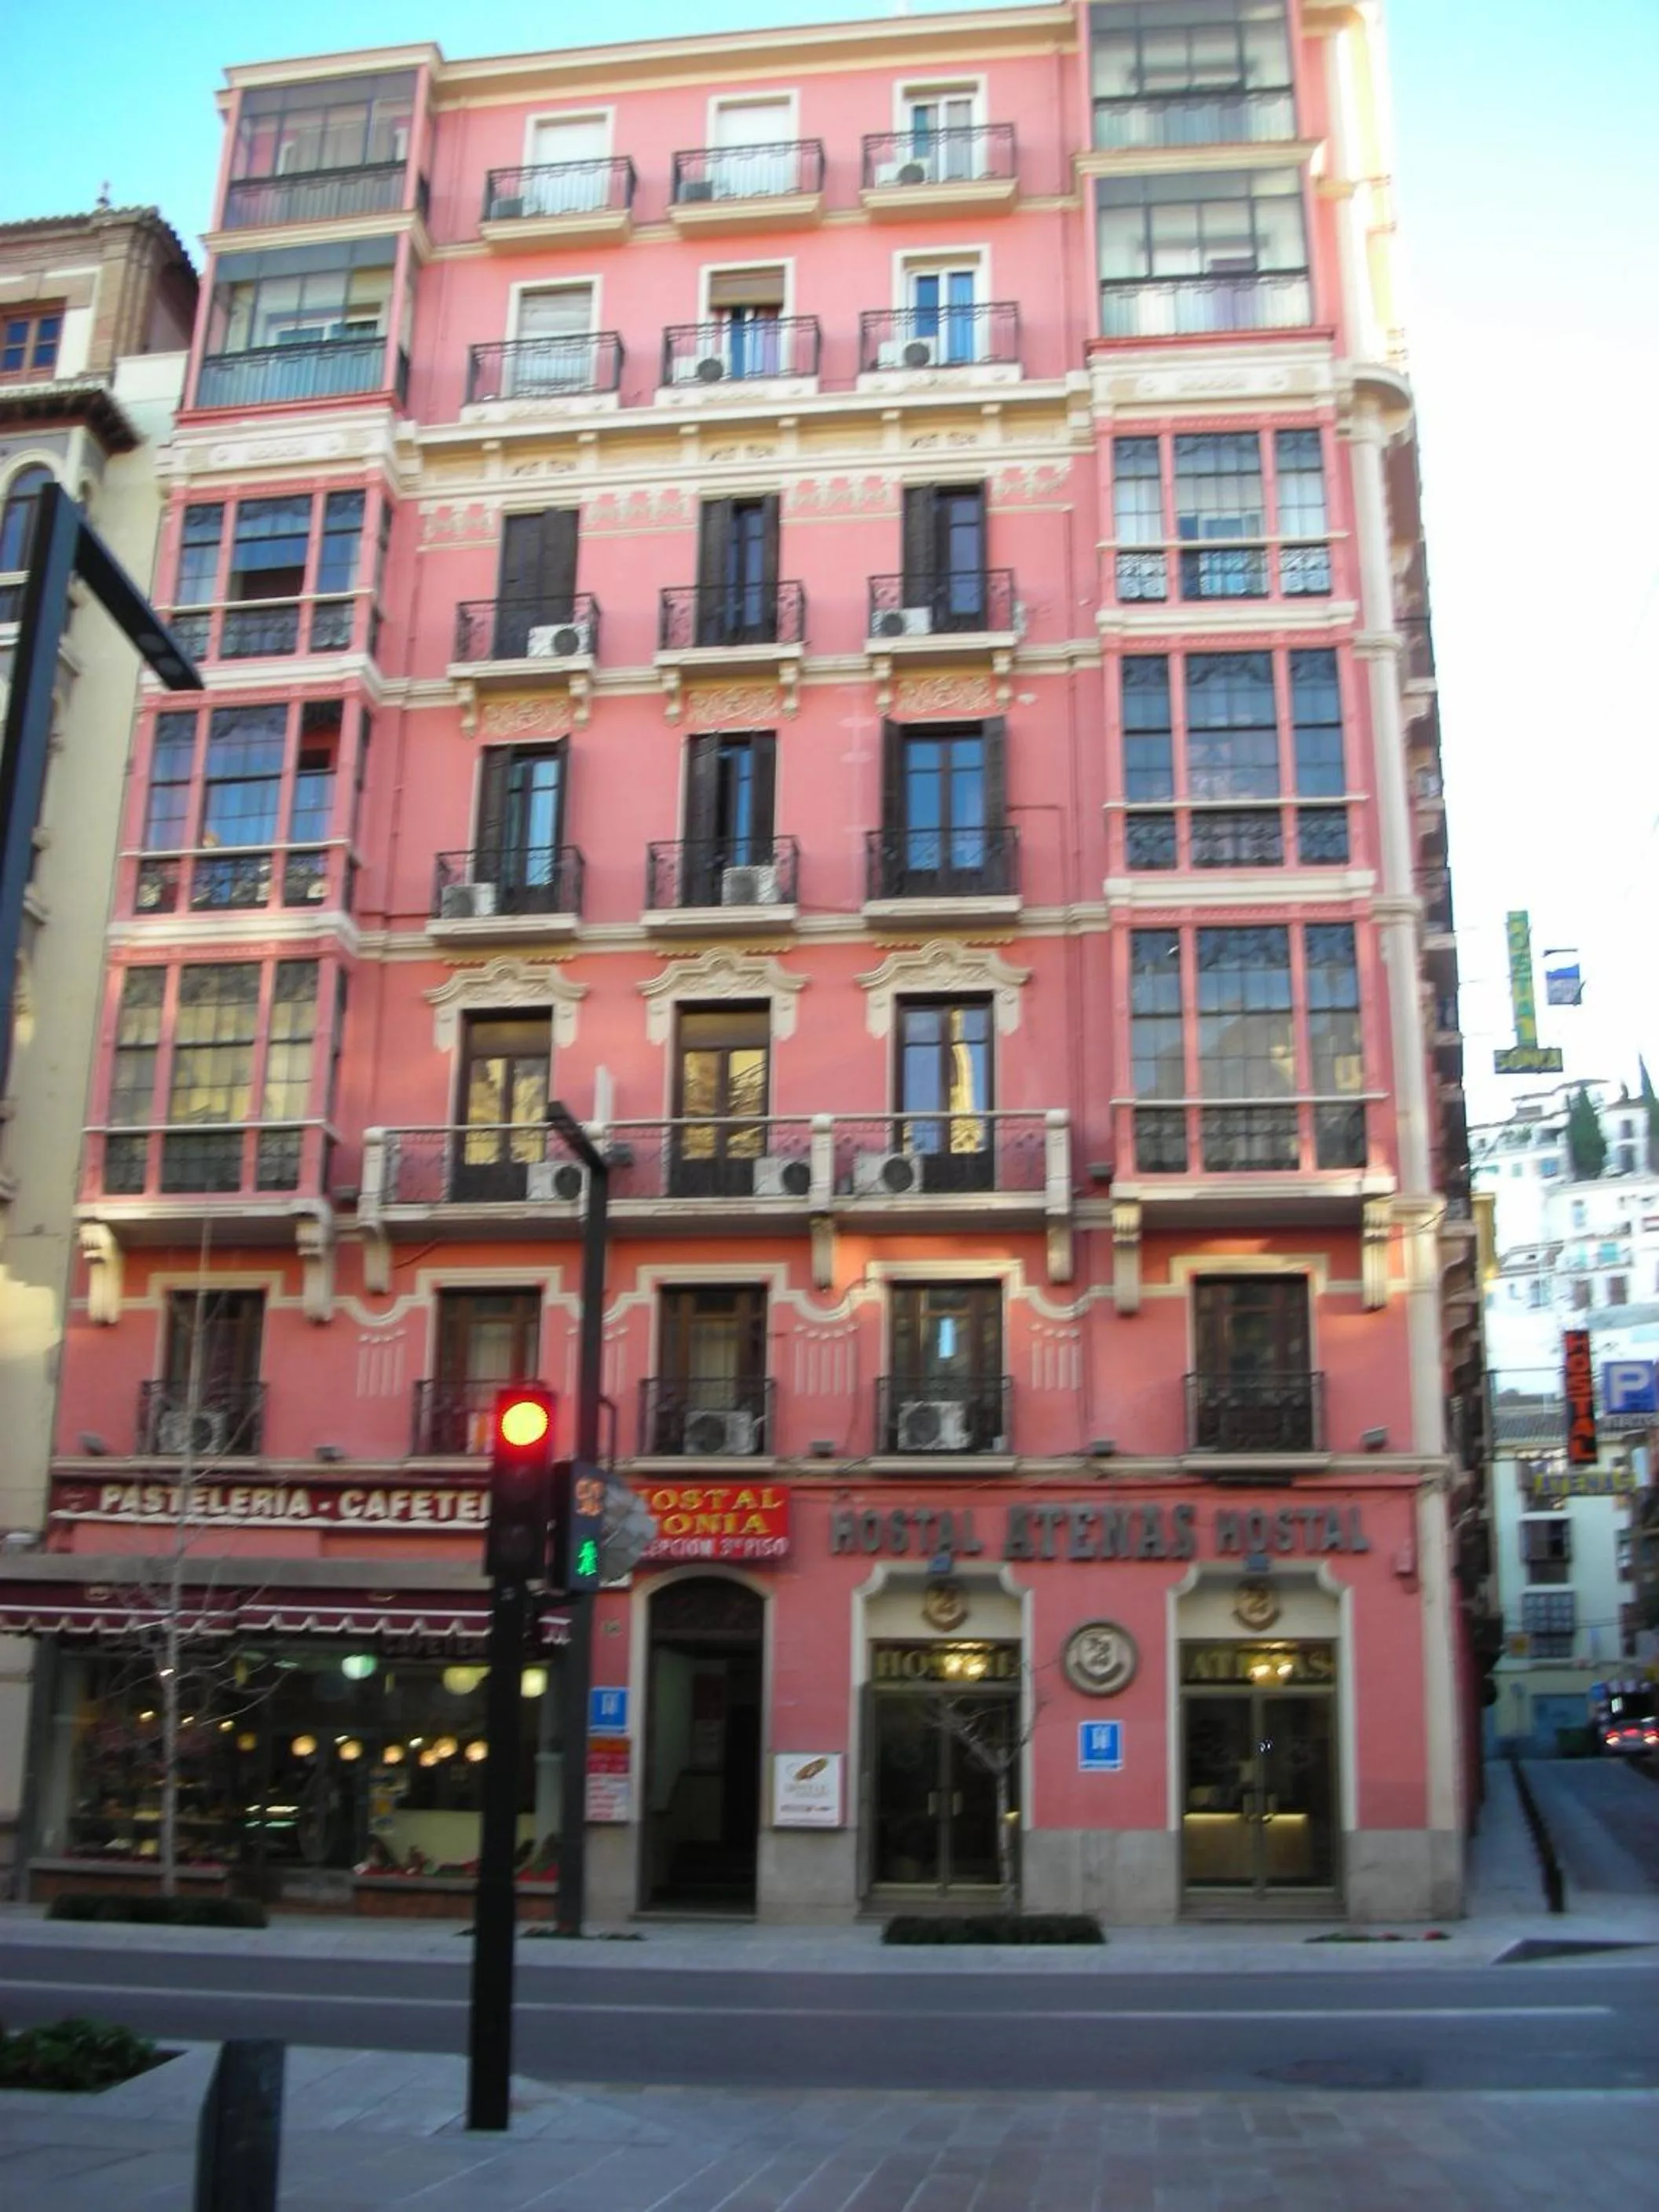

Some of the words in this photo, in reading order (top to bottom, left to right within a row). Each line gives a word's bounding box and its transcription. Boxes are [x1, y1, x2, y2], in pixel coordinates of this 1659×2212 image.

[1609, 1364, 1650, 1409] P
[100, 1485, 312, 1518] PASTELERIA
[338, 1489, 493, 1521] CAFETE
[638, 1488, 784, 1511] OSTAL
[652, 1512, 772, 1535] ONIA
[830, 1508, 983, 1556] HOSTAL
[1004, 1503, 1197, 1560] ATENAS
[1215, 1505, 1371, 1554] HOSTAL
